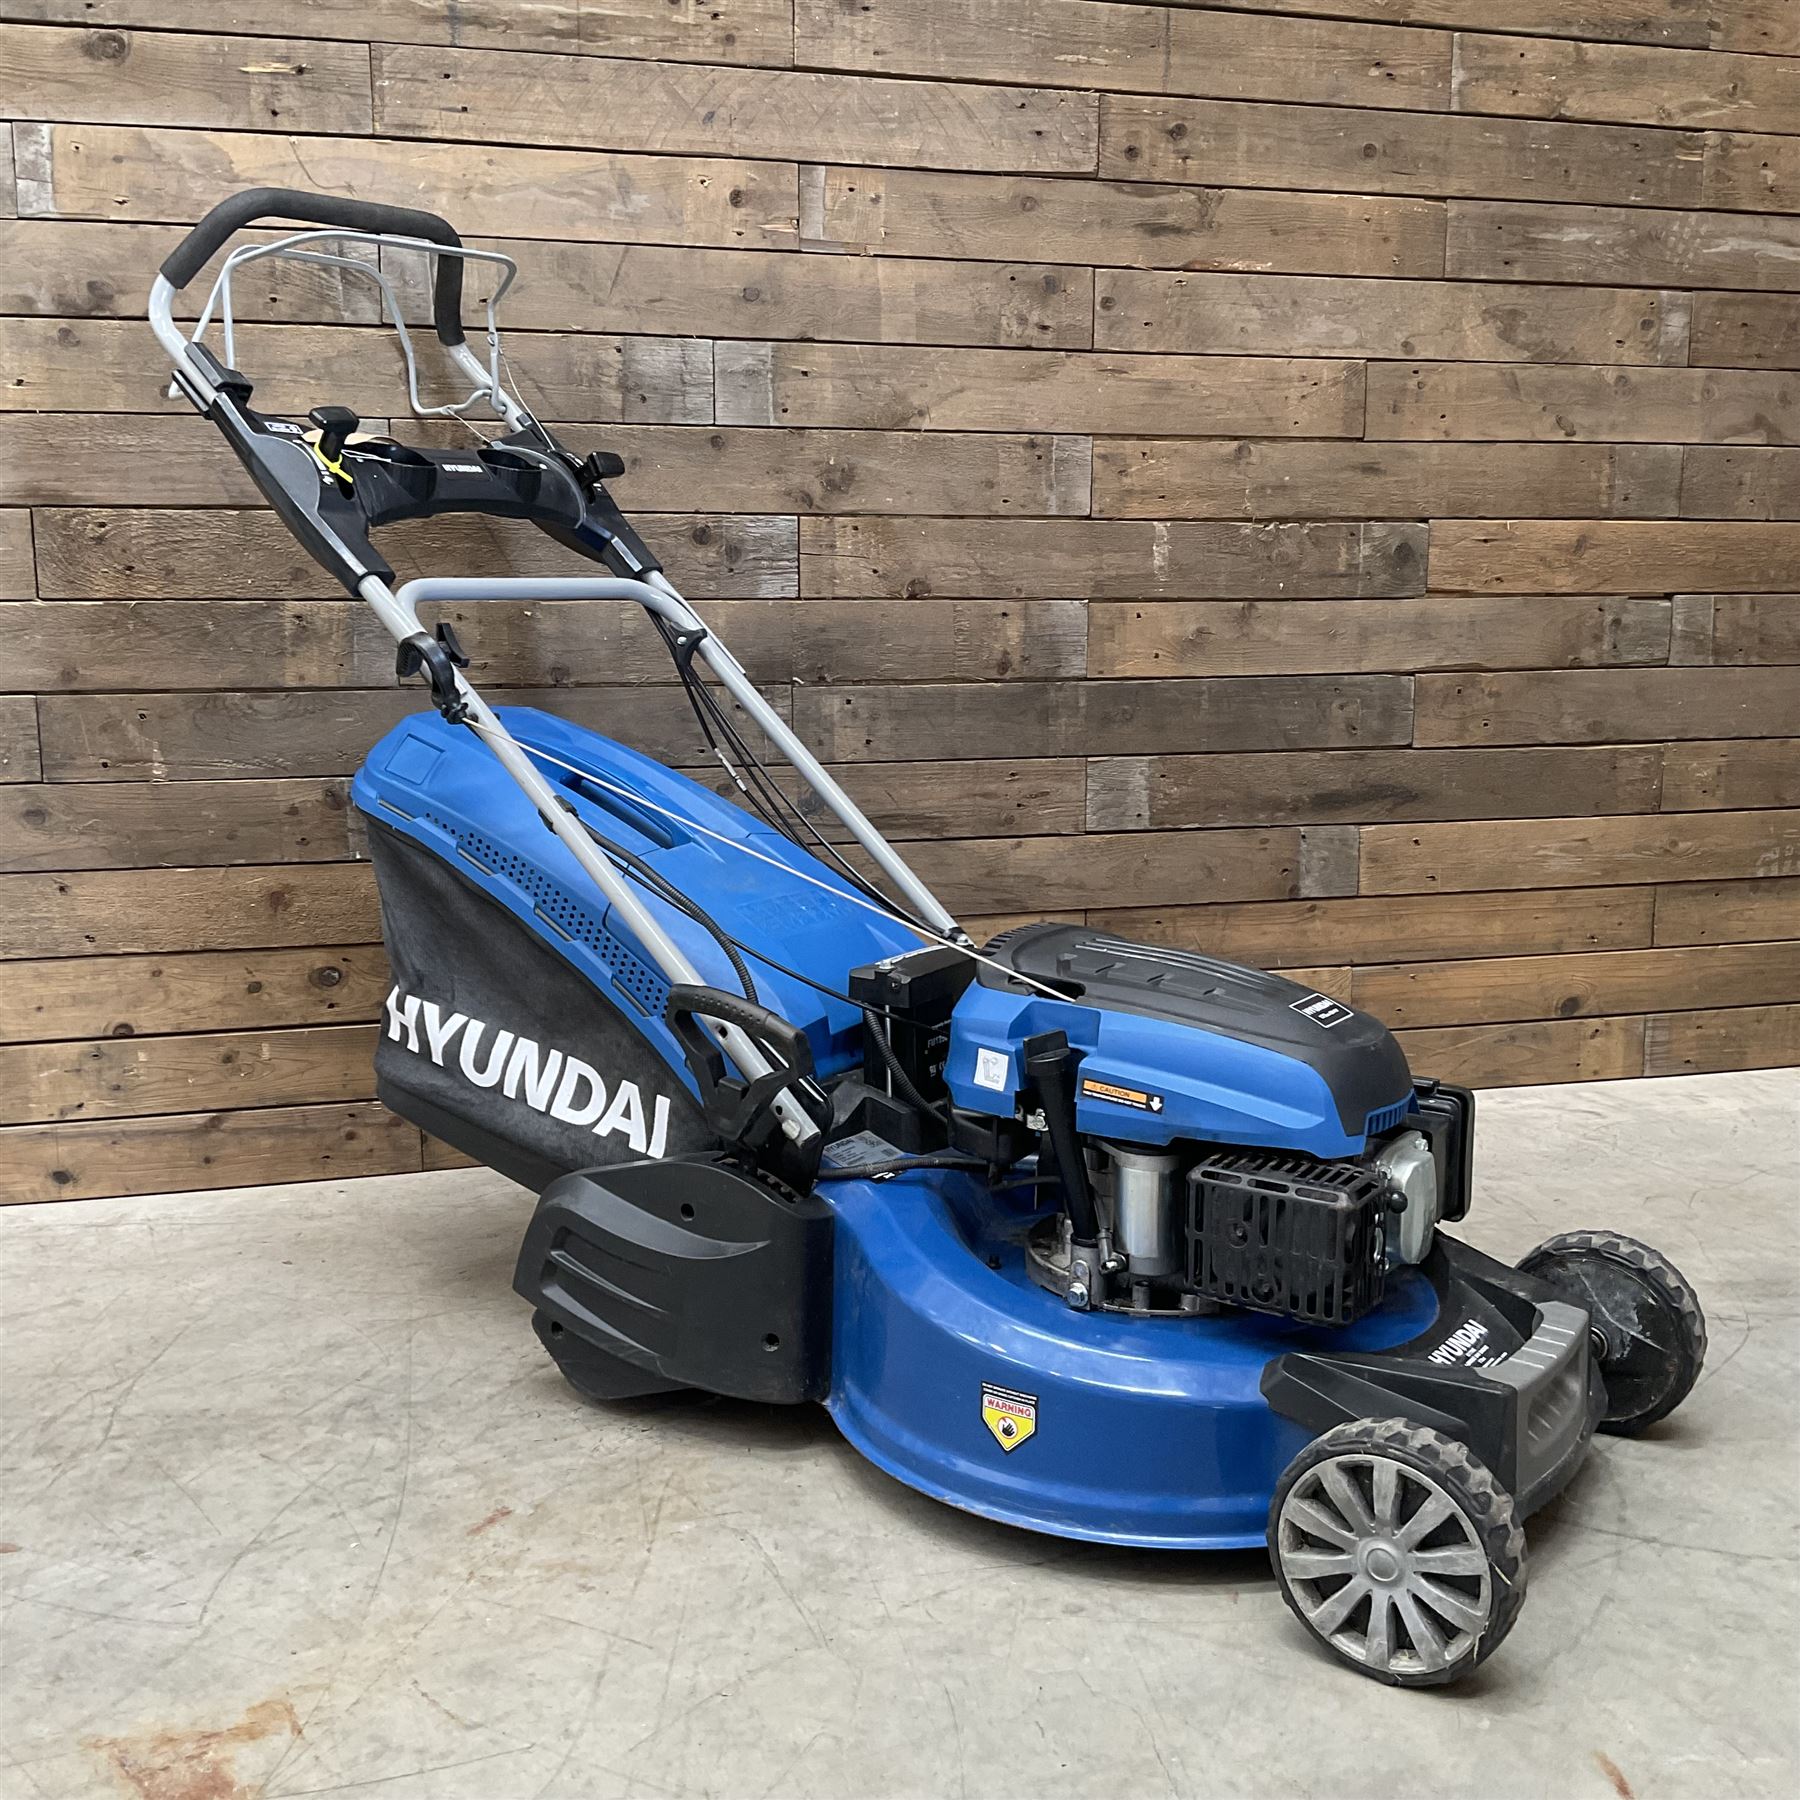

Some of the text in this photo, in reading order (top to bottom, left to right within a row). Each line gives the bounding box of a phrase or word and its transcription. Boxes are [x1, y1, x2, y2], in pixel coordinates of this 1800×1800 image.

[386, 985, 671, 1159] HYUNDAI
[1099, 1084, 1130, 1098] CAUTION
[1428, 1319, 1488, 1365] HYUNDAI
[987, 1398, 1031, 1417] WARNING
